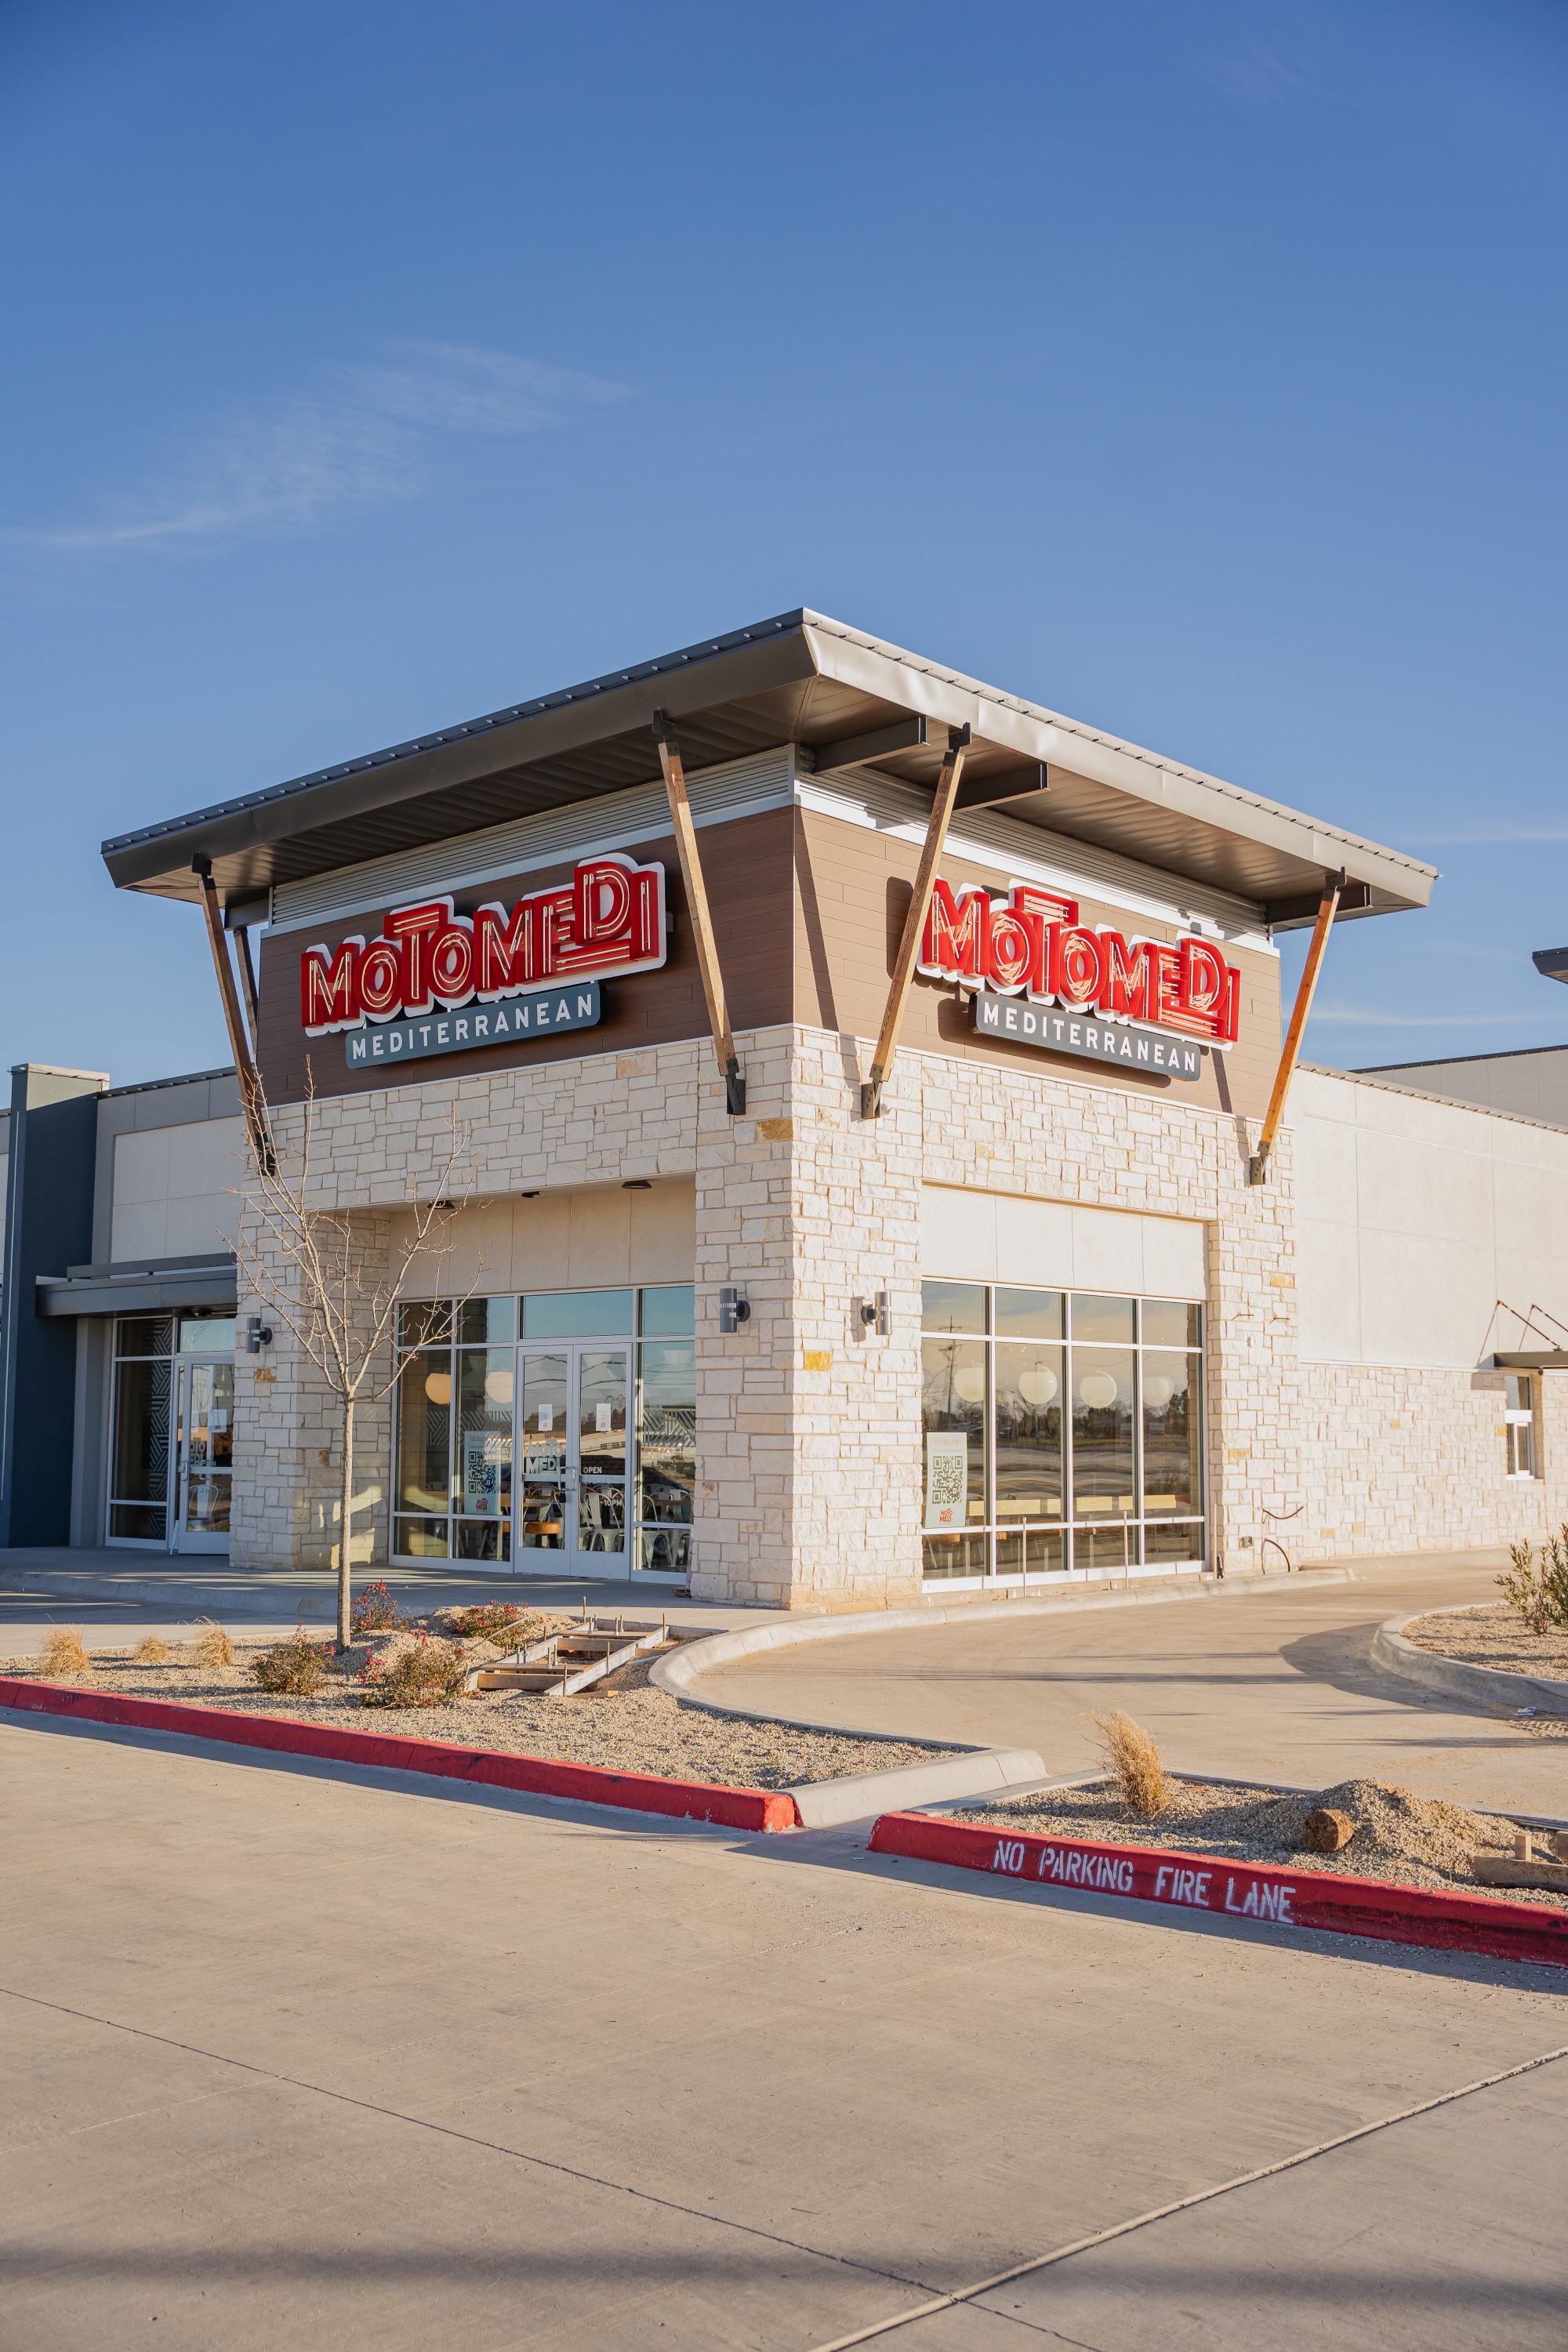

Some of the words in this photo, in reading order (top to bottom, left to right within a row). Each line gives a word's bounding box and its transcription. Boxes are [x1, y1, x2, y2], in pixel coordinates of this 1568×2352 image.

[301, 861, 659, 1029] MOTOMEDI
[922, 878, 1241, 1043] MOTOMEDI
[352, 993, 593, 1060] MEDITERRANEAN
[983, 1001, 1196, 1073] MEDITERRANEAN
[191, 1437, 205, 1453] OTO
[526, 1457, 561, 1474] MEDI
[528, 1439, 564, 1457] MOTO
[994, 1840, 1025, 1872] NO
[1040, 1847, 1134, 1892] PARKING
[1155, 1867, 1212, 1906] FIRE
[1225, 1876, 1297, 1924] LANE
